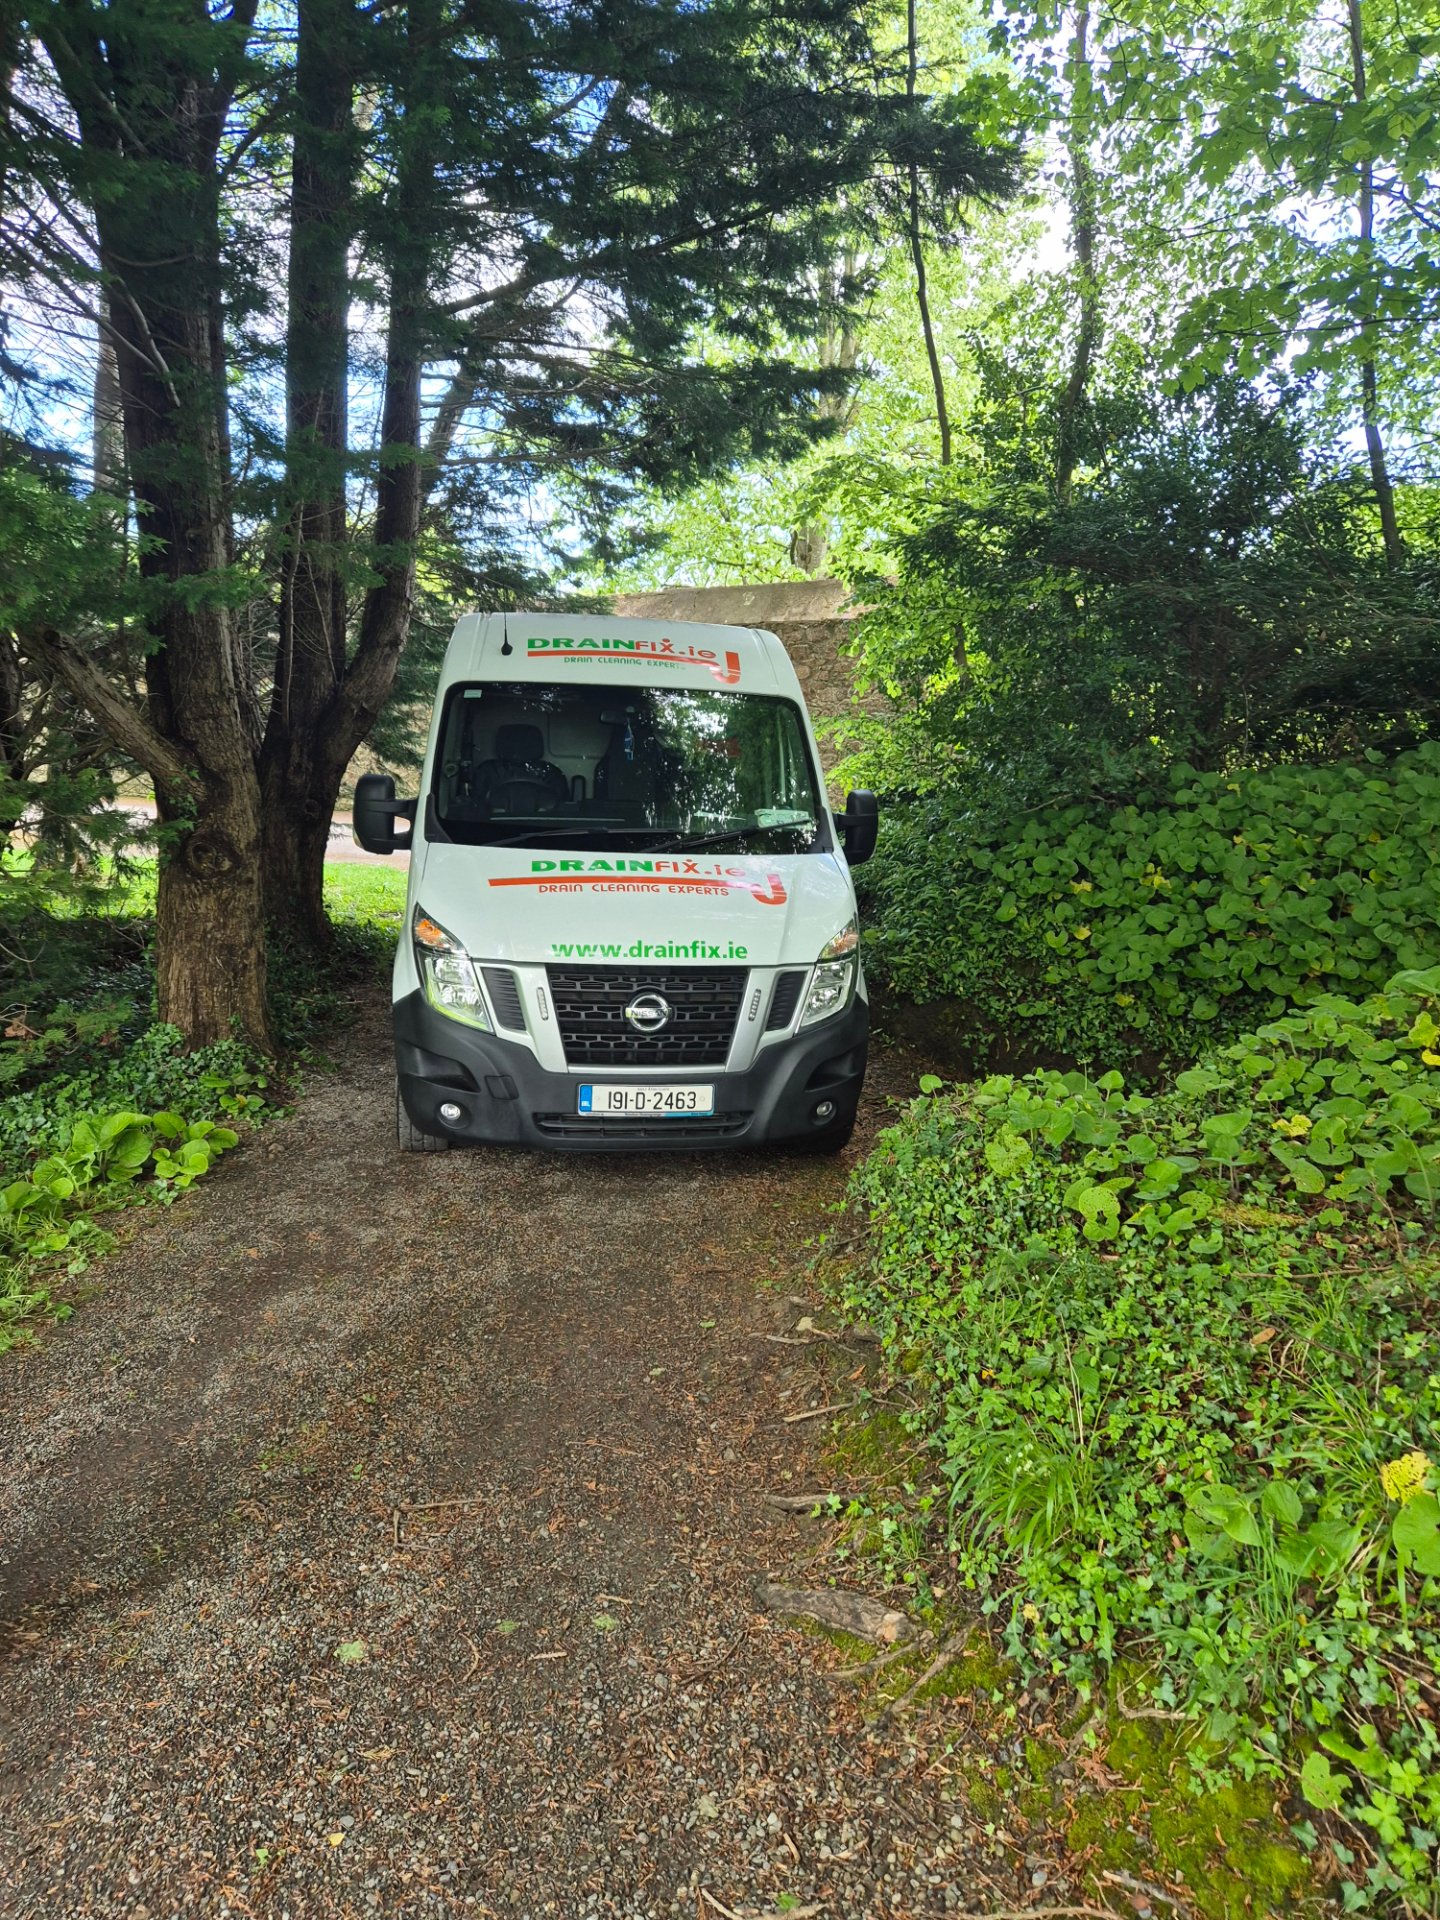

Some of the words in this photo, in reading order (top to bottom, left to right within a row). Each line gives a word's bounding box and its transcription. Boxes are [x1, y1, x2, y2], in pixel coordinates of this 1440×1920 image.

[527, 638, 716, 658] DRAINFIX.ie
[563, 656, 593, 664] DRAIN
[598, 657, 642, 666] CLEANING
[531, 859, 745, 876] DRAINFIX.ie
[538, 883, 583, 893] DRAIN
[591, 883, 660, 894] CLEANING
[668, 885, 729, 896] EXPERTS
[551, 940, 748, 959] www.drainfix.ie
[608, 1091, 697, 1110] 191-D-2463
